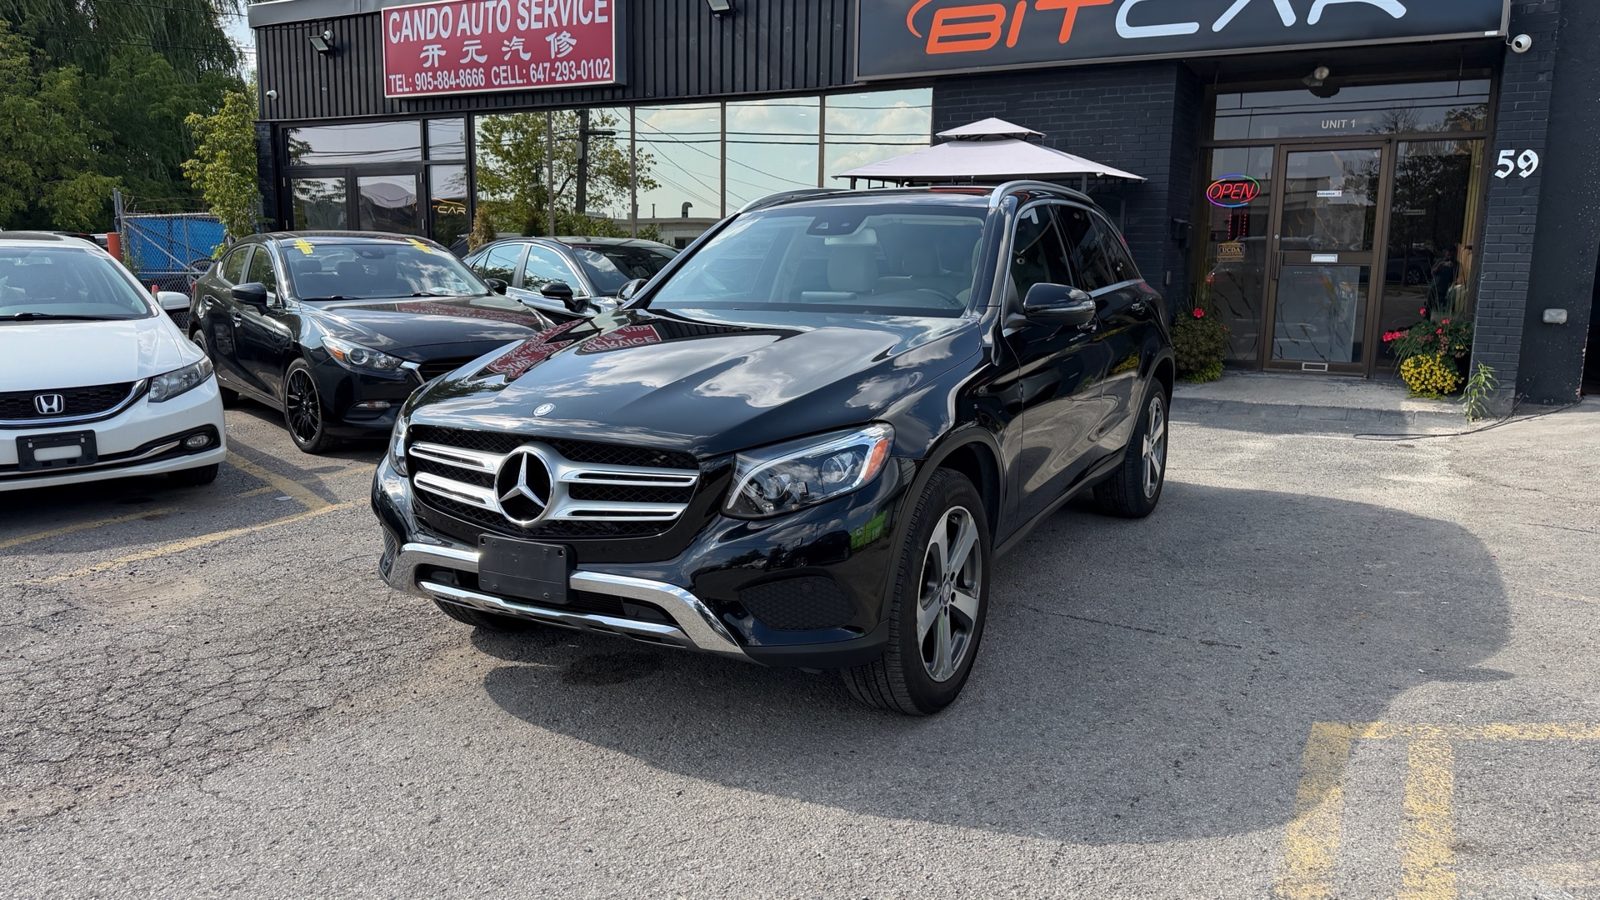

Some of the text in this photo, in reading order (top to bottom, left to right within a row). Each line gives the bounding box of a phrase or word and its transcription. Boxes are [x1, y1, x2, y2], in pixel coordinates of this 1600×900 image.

[388, 0, 609, 44] CANDO AUTO SERVICE
[419, 30, 577, 68] 开元汽修
[388, 58, 611, 93] TEL: 905-884-8666 CELL: 647-293-0102
[1321, 119, 1357, 129] UNIT 1
[1494, 149, 1539, 179] 59
[1209, 183, 1255, 199] OPEN
